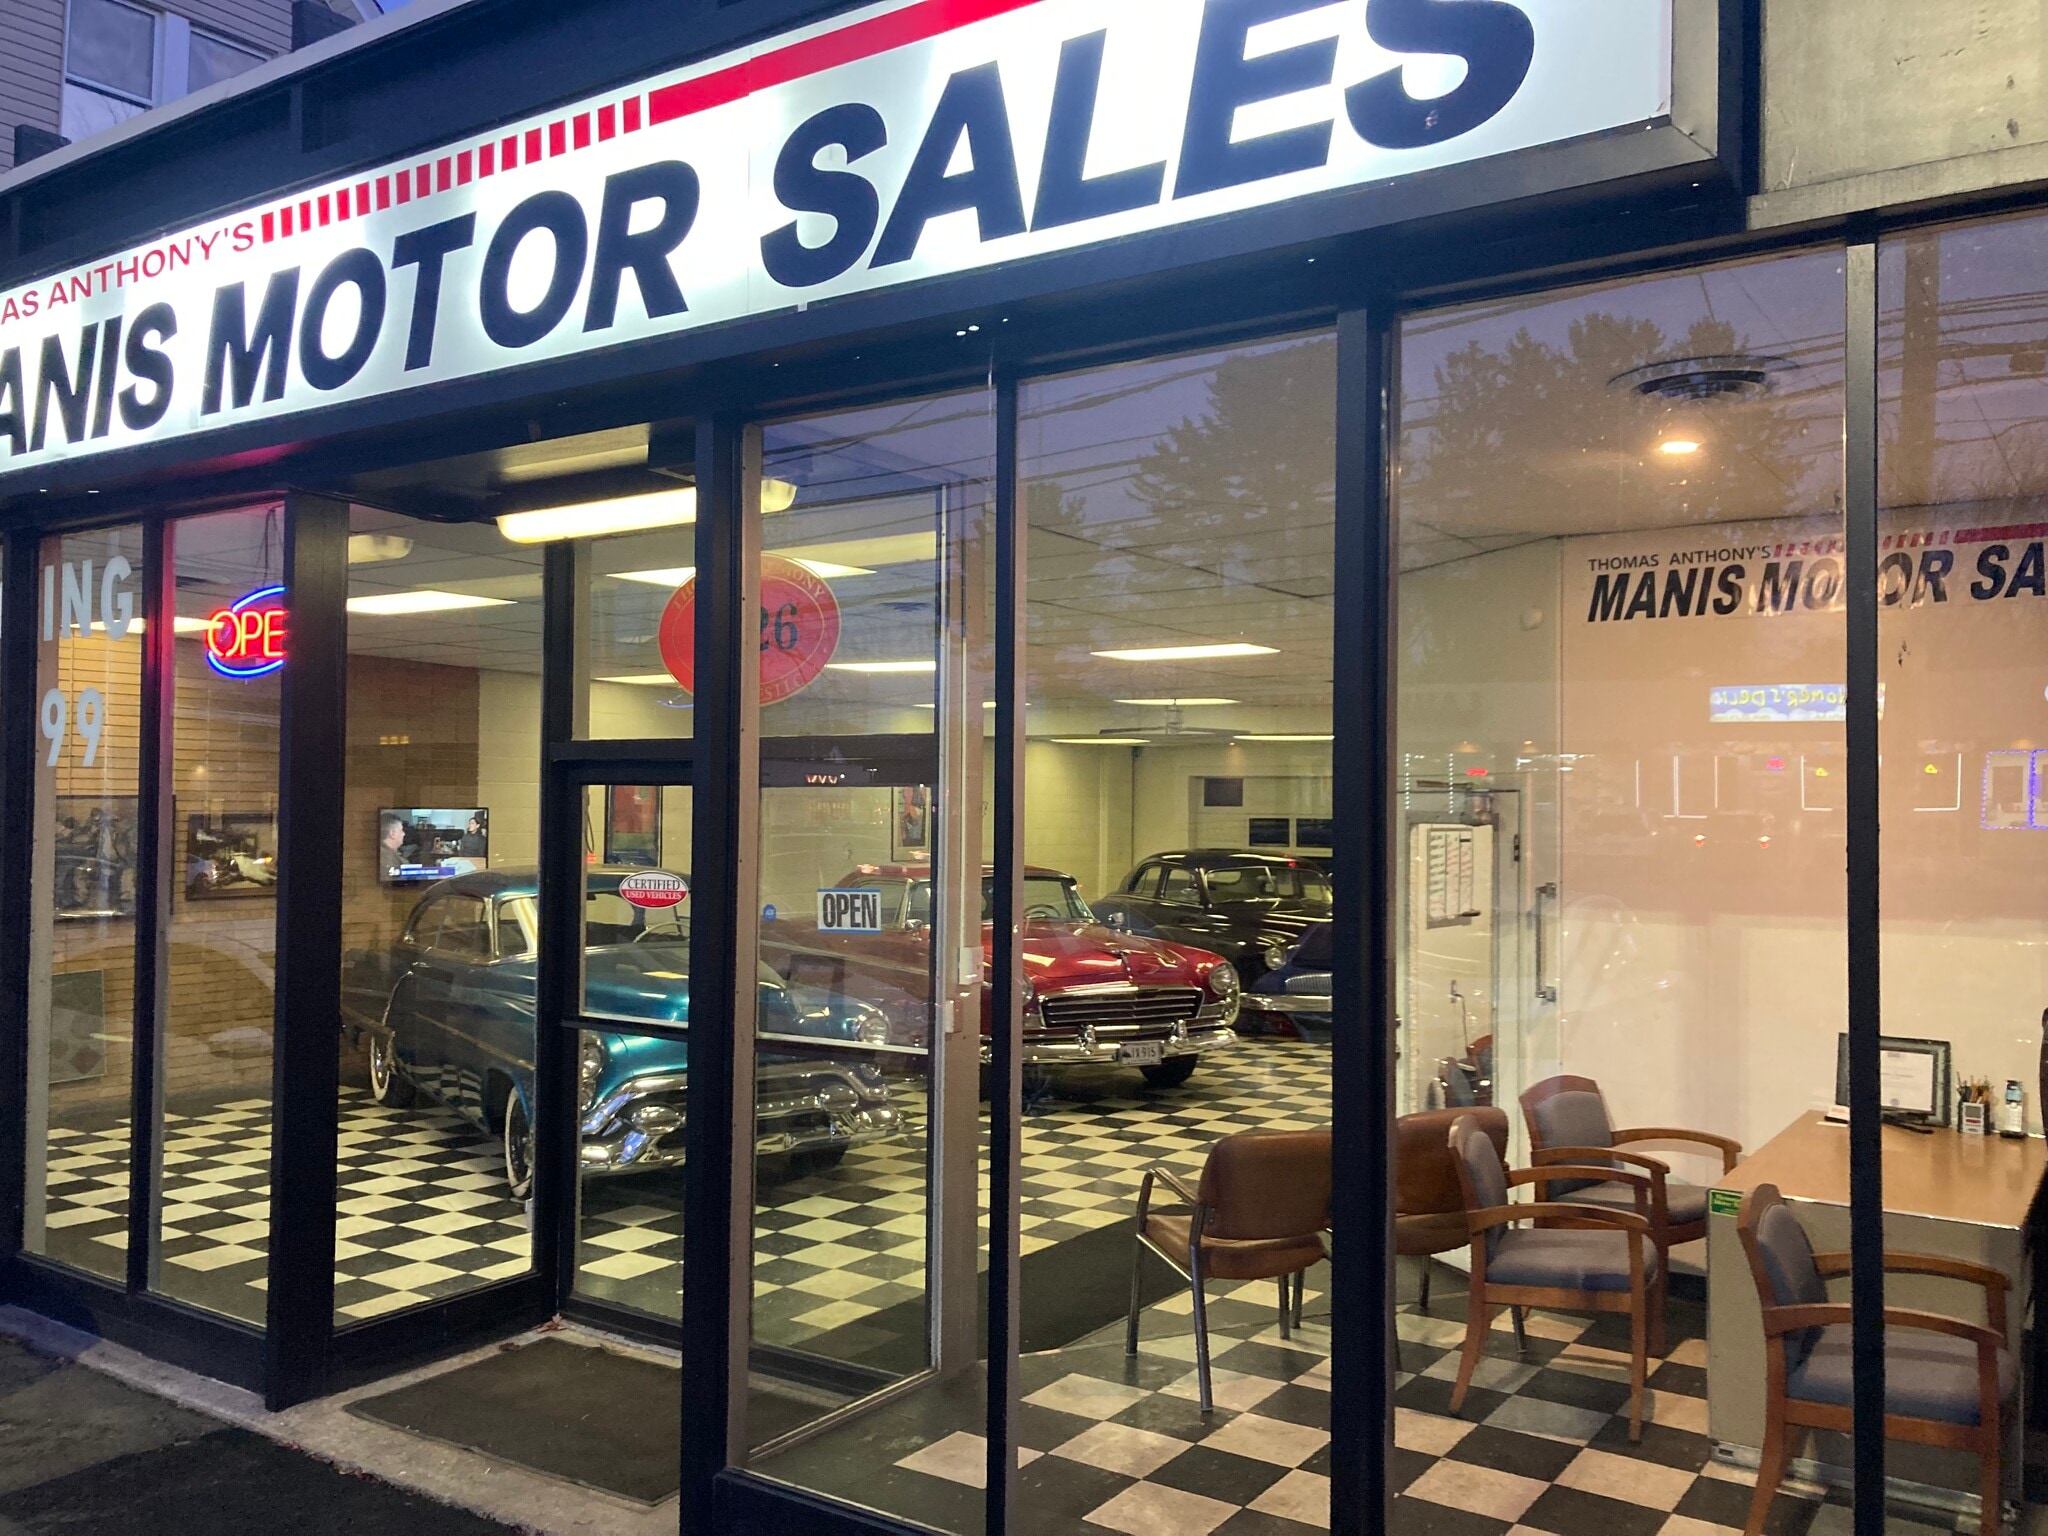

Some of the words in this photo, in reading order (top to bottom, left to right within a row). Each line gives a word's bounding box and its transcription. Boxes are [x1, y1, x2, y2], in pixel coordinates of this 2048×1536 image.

[0, 301, 178, 457] ANIS
[201, 159, 699, 417] MOTOR
[760, 0, 1535, 287] SALES
[0, 290, 39, 325] AS
[47, 222, 254, 310] ANTHONY'S
[1587, 564, 1745, 623] MANIS
[1756, 549, 1954, 612] MOOR
[1970, 542, 2046, 600] SA
[1588, 553, 1660, 572] THOMAS
[1669, 544, 1772, 565] ANTHONY'S
[43, 555, 133, 643] ING
[41, 687, 104, 767] 99
[626, 890, 646, 899] USED
[646, 891, 682, 900] VEHICLES
[627, 879, 681, 890] CERTIFIED
[822, 893, 878, 929] OPEN
